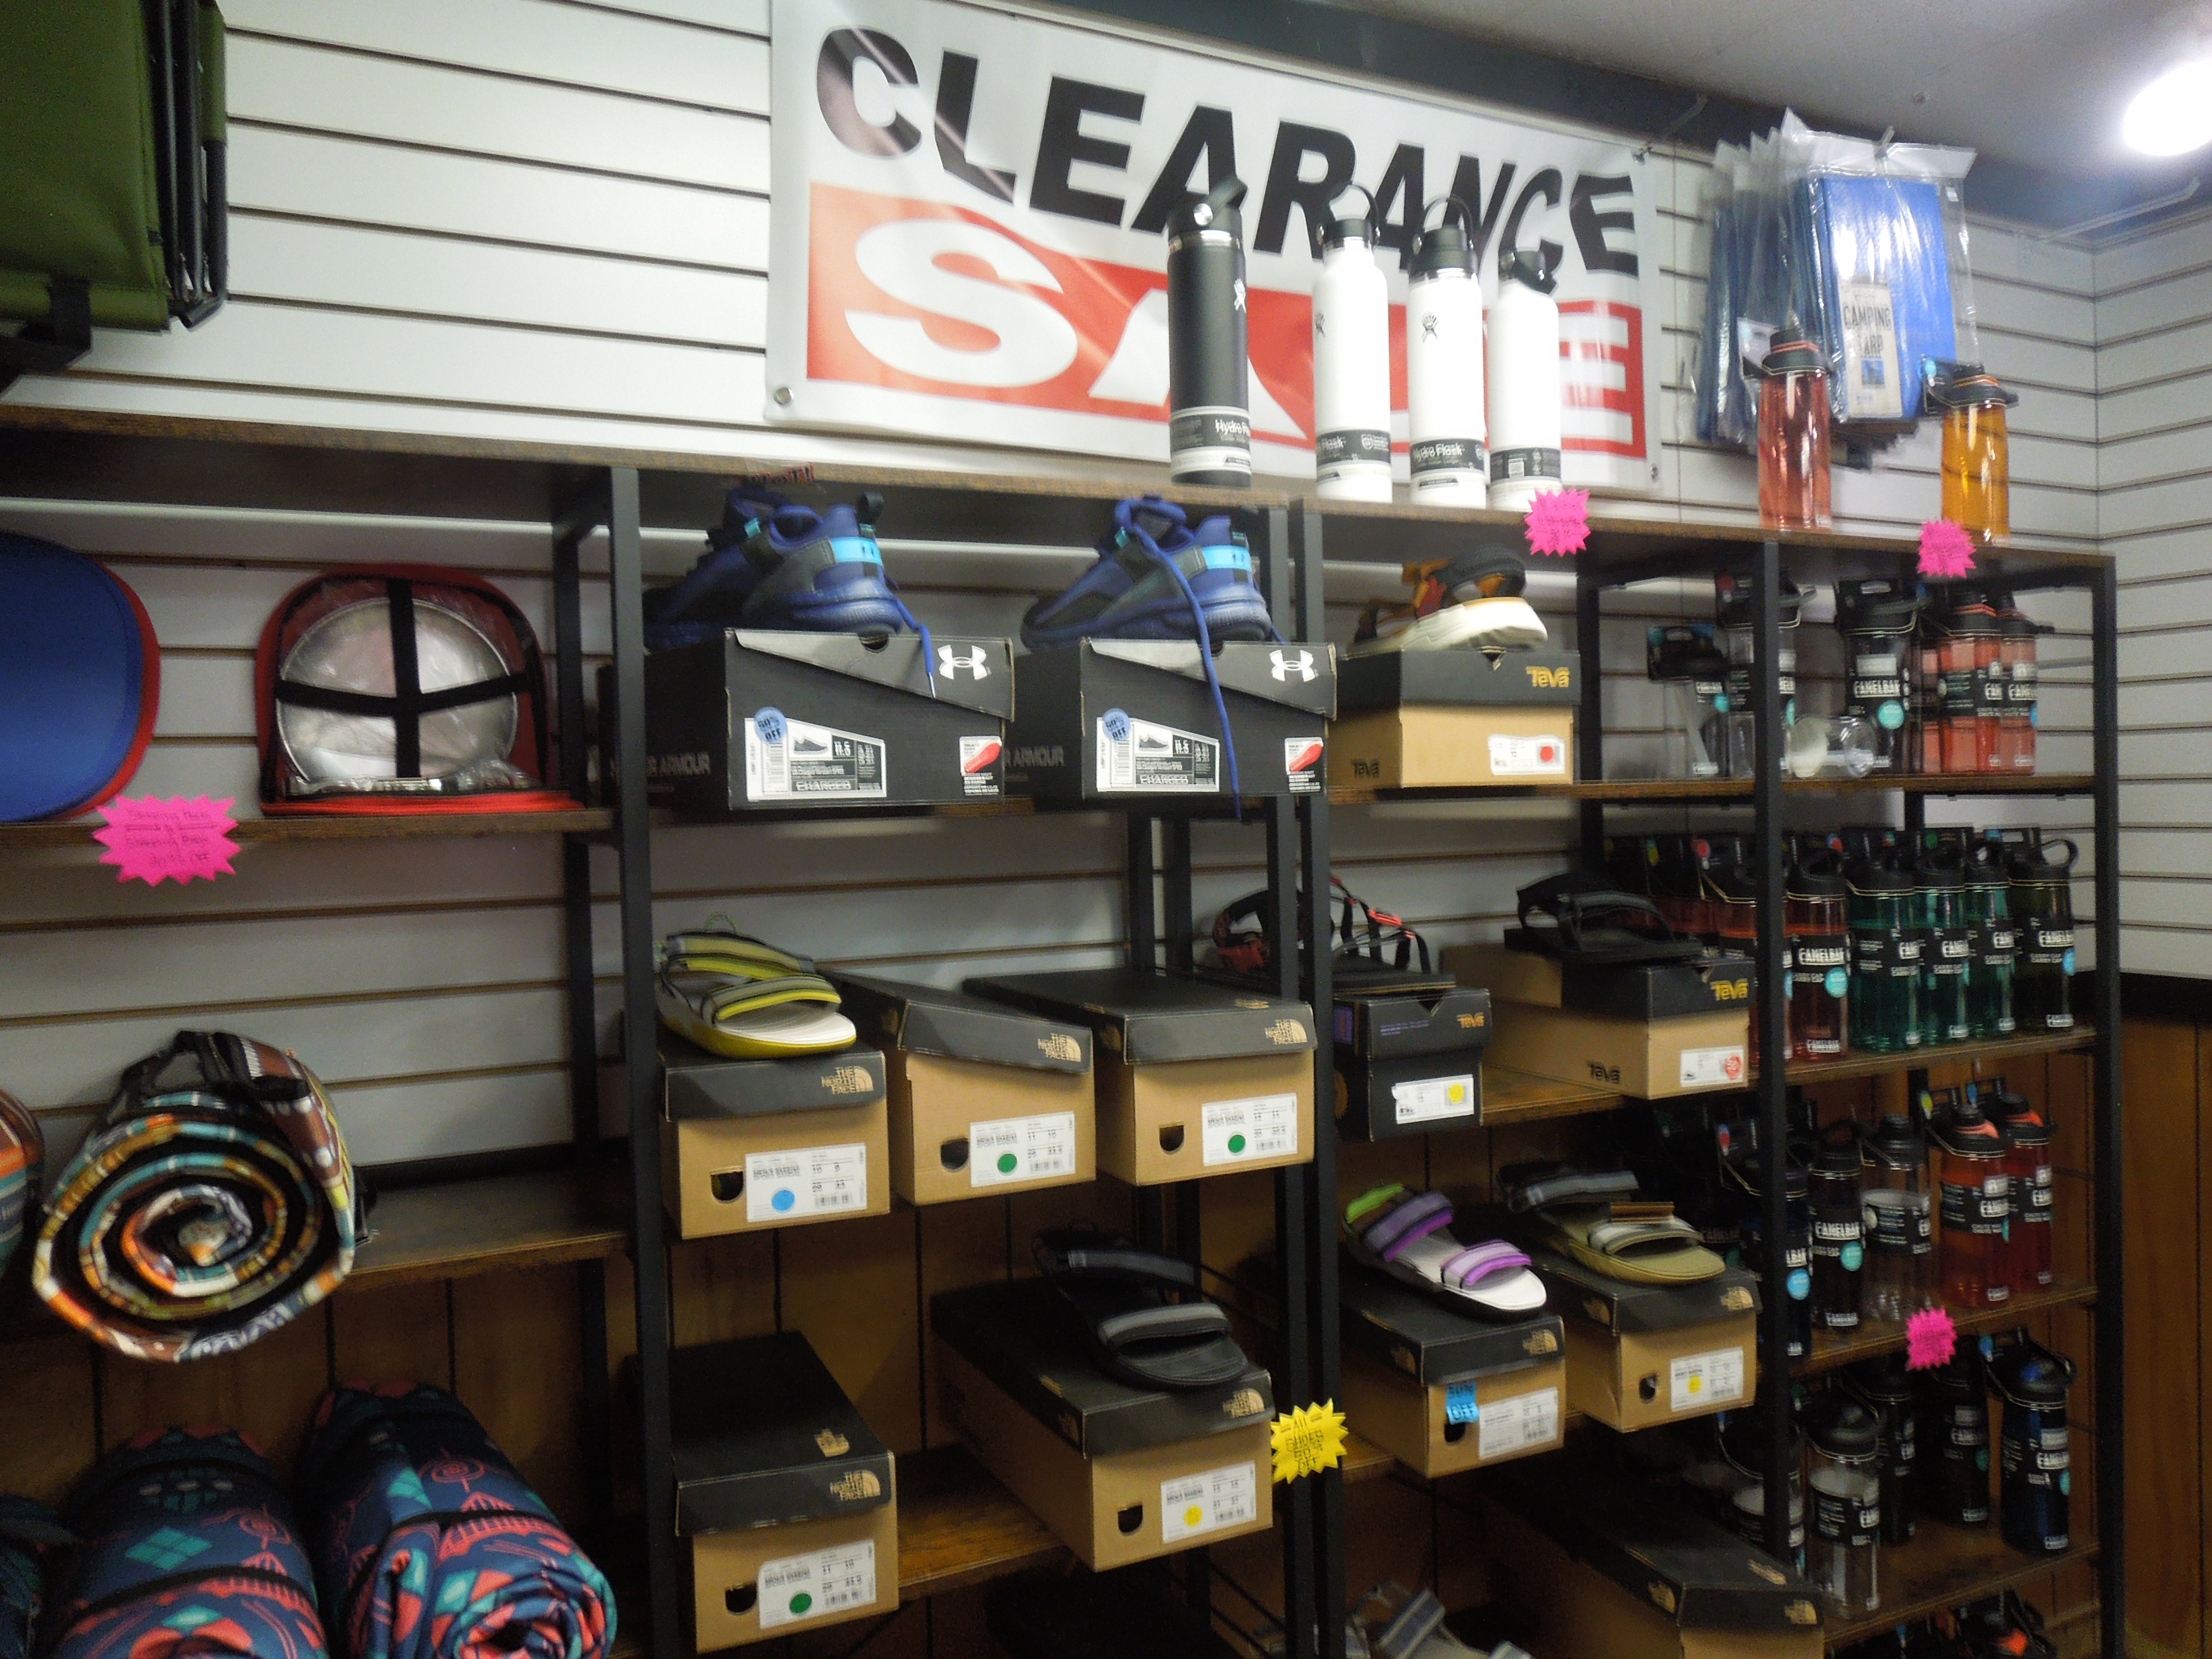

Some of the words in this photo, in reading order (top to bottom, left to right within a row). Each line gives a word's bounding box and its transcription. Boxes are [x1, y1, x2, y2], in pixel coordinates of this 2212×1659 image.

[816, 27, 1639, 284] CLEARANCE
[1843, 304, 1891, 331] CAMPING
[843, 218, 1631, 444] SAE
[796, 780, 851, 791] CHARGED
[1140, 774, 1189, 784] CHARGED
[1798, 947, 1846, 966] CAMELBAK
[1037, 1038, 1067, 1053] NORTH
[834, 1066, 855, 1079] THE
[820, 1075, 855, 1088] NORTH
[830, 1083, 856, 1094] FACE
[1786, 1248, 1808, 1267] LBAK
[844, 1470, 863, 1482] THE
[830, 1479, 864, 1494] NORTH
[840, 1488, 865, 1501] FACE
